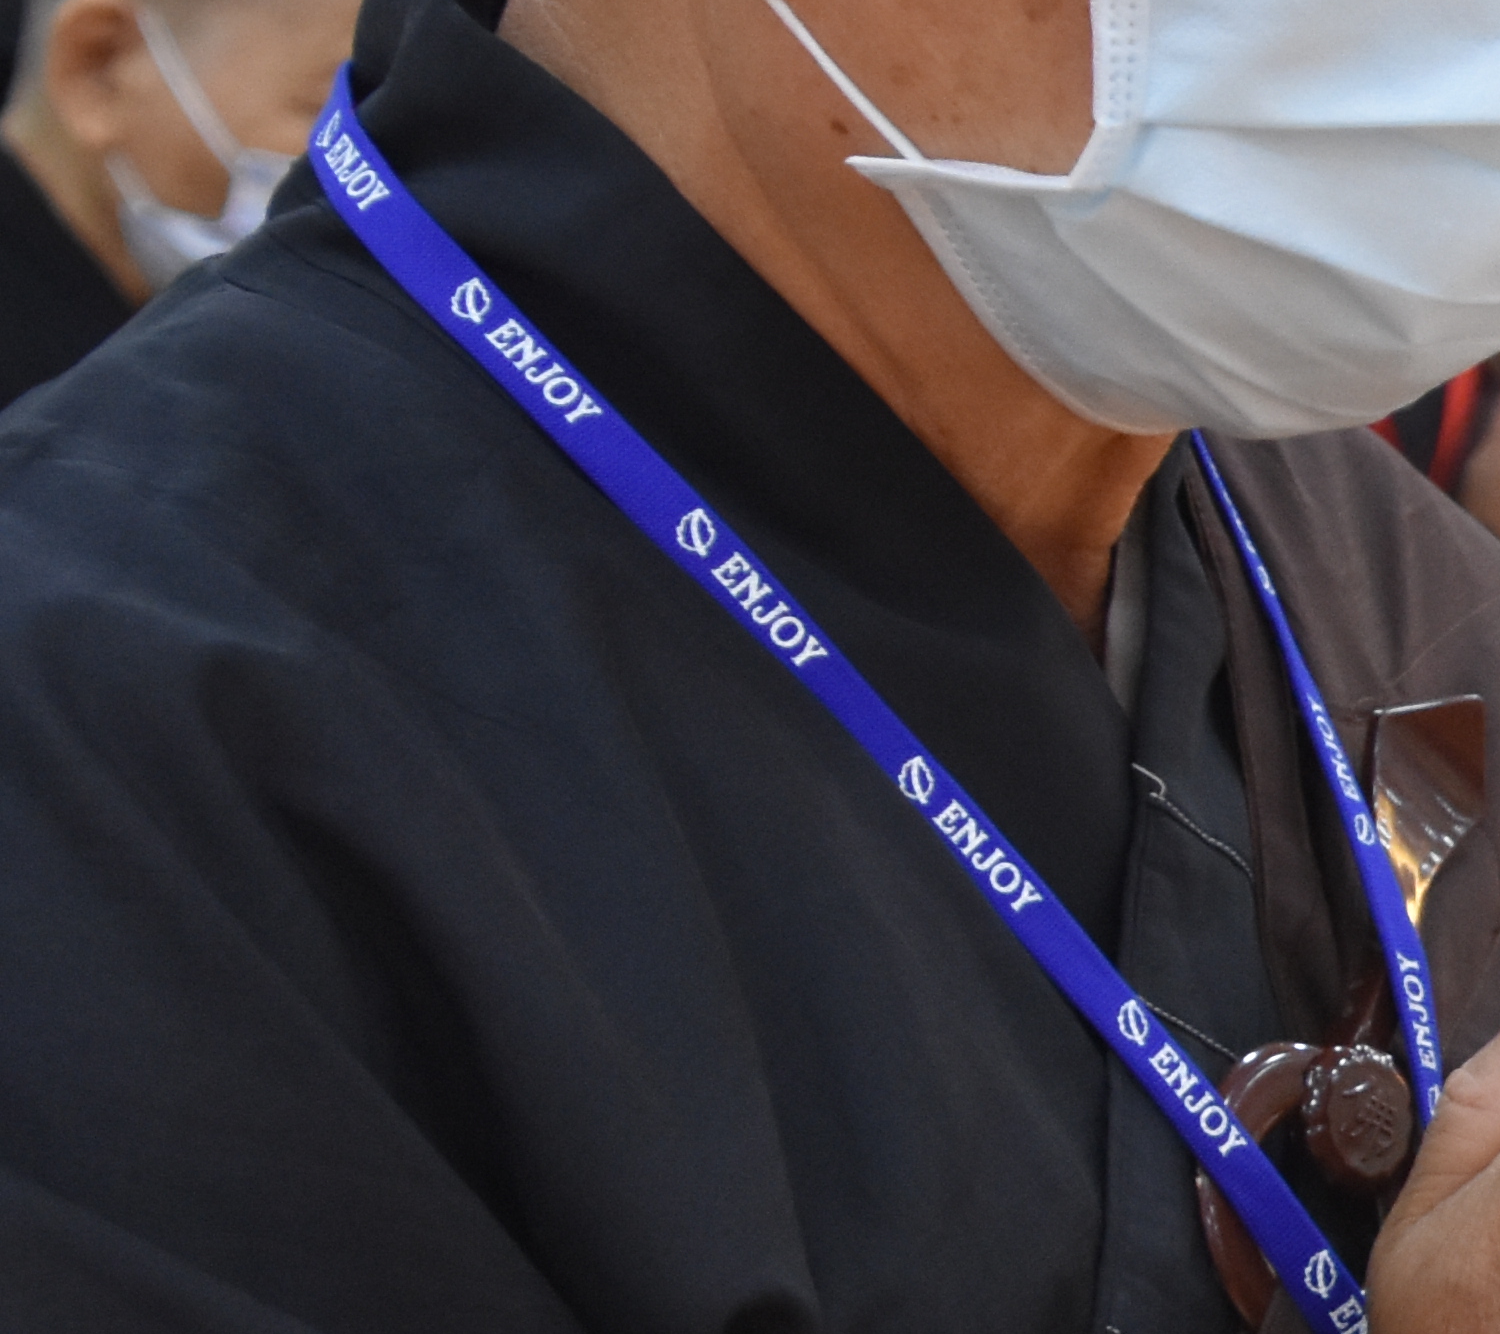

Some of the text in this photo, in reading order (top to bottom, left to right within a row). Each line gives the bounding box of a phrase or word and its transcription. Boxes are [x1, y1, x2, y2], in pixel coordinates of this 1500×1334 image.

[324, 133, 391, 210] ENJOY
[484, 318, 603, 423] ENJOY
[711, 551, 828, 667] ENJOY
[1306, 693, 1361, 802] ENJOY
[932, 799, 1043, 912] ENJOY
[1396, 951, 1437, 1071] ENJOY
[1148, 1042, 1248, 1157] ENJOY
